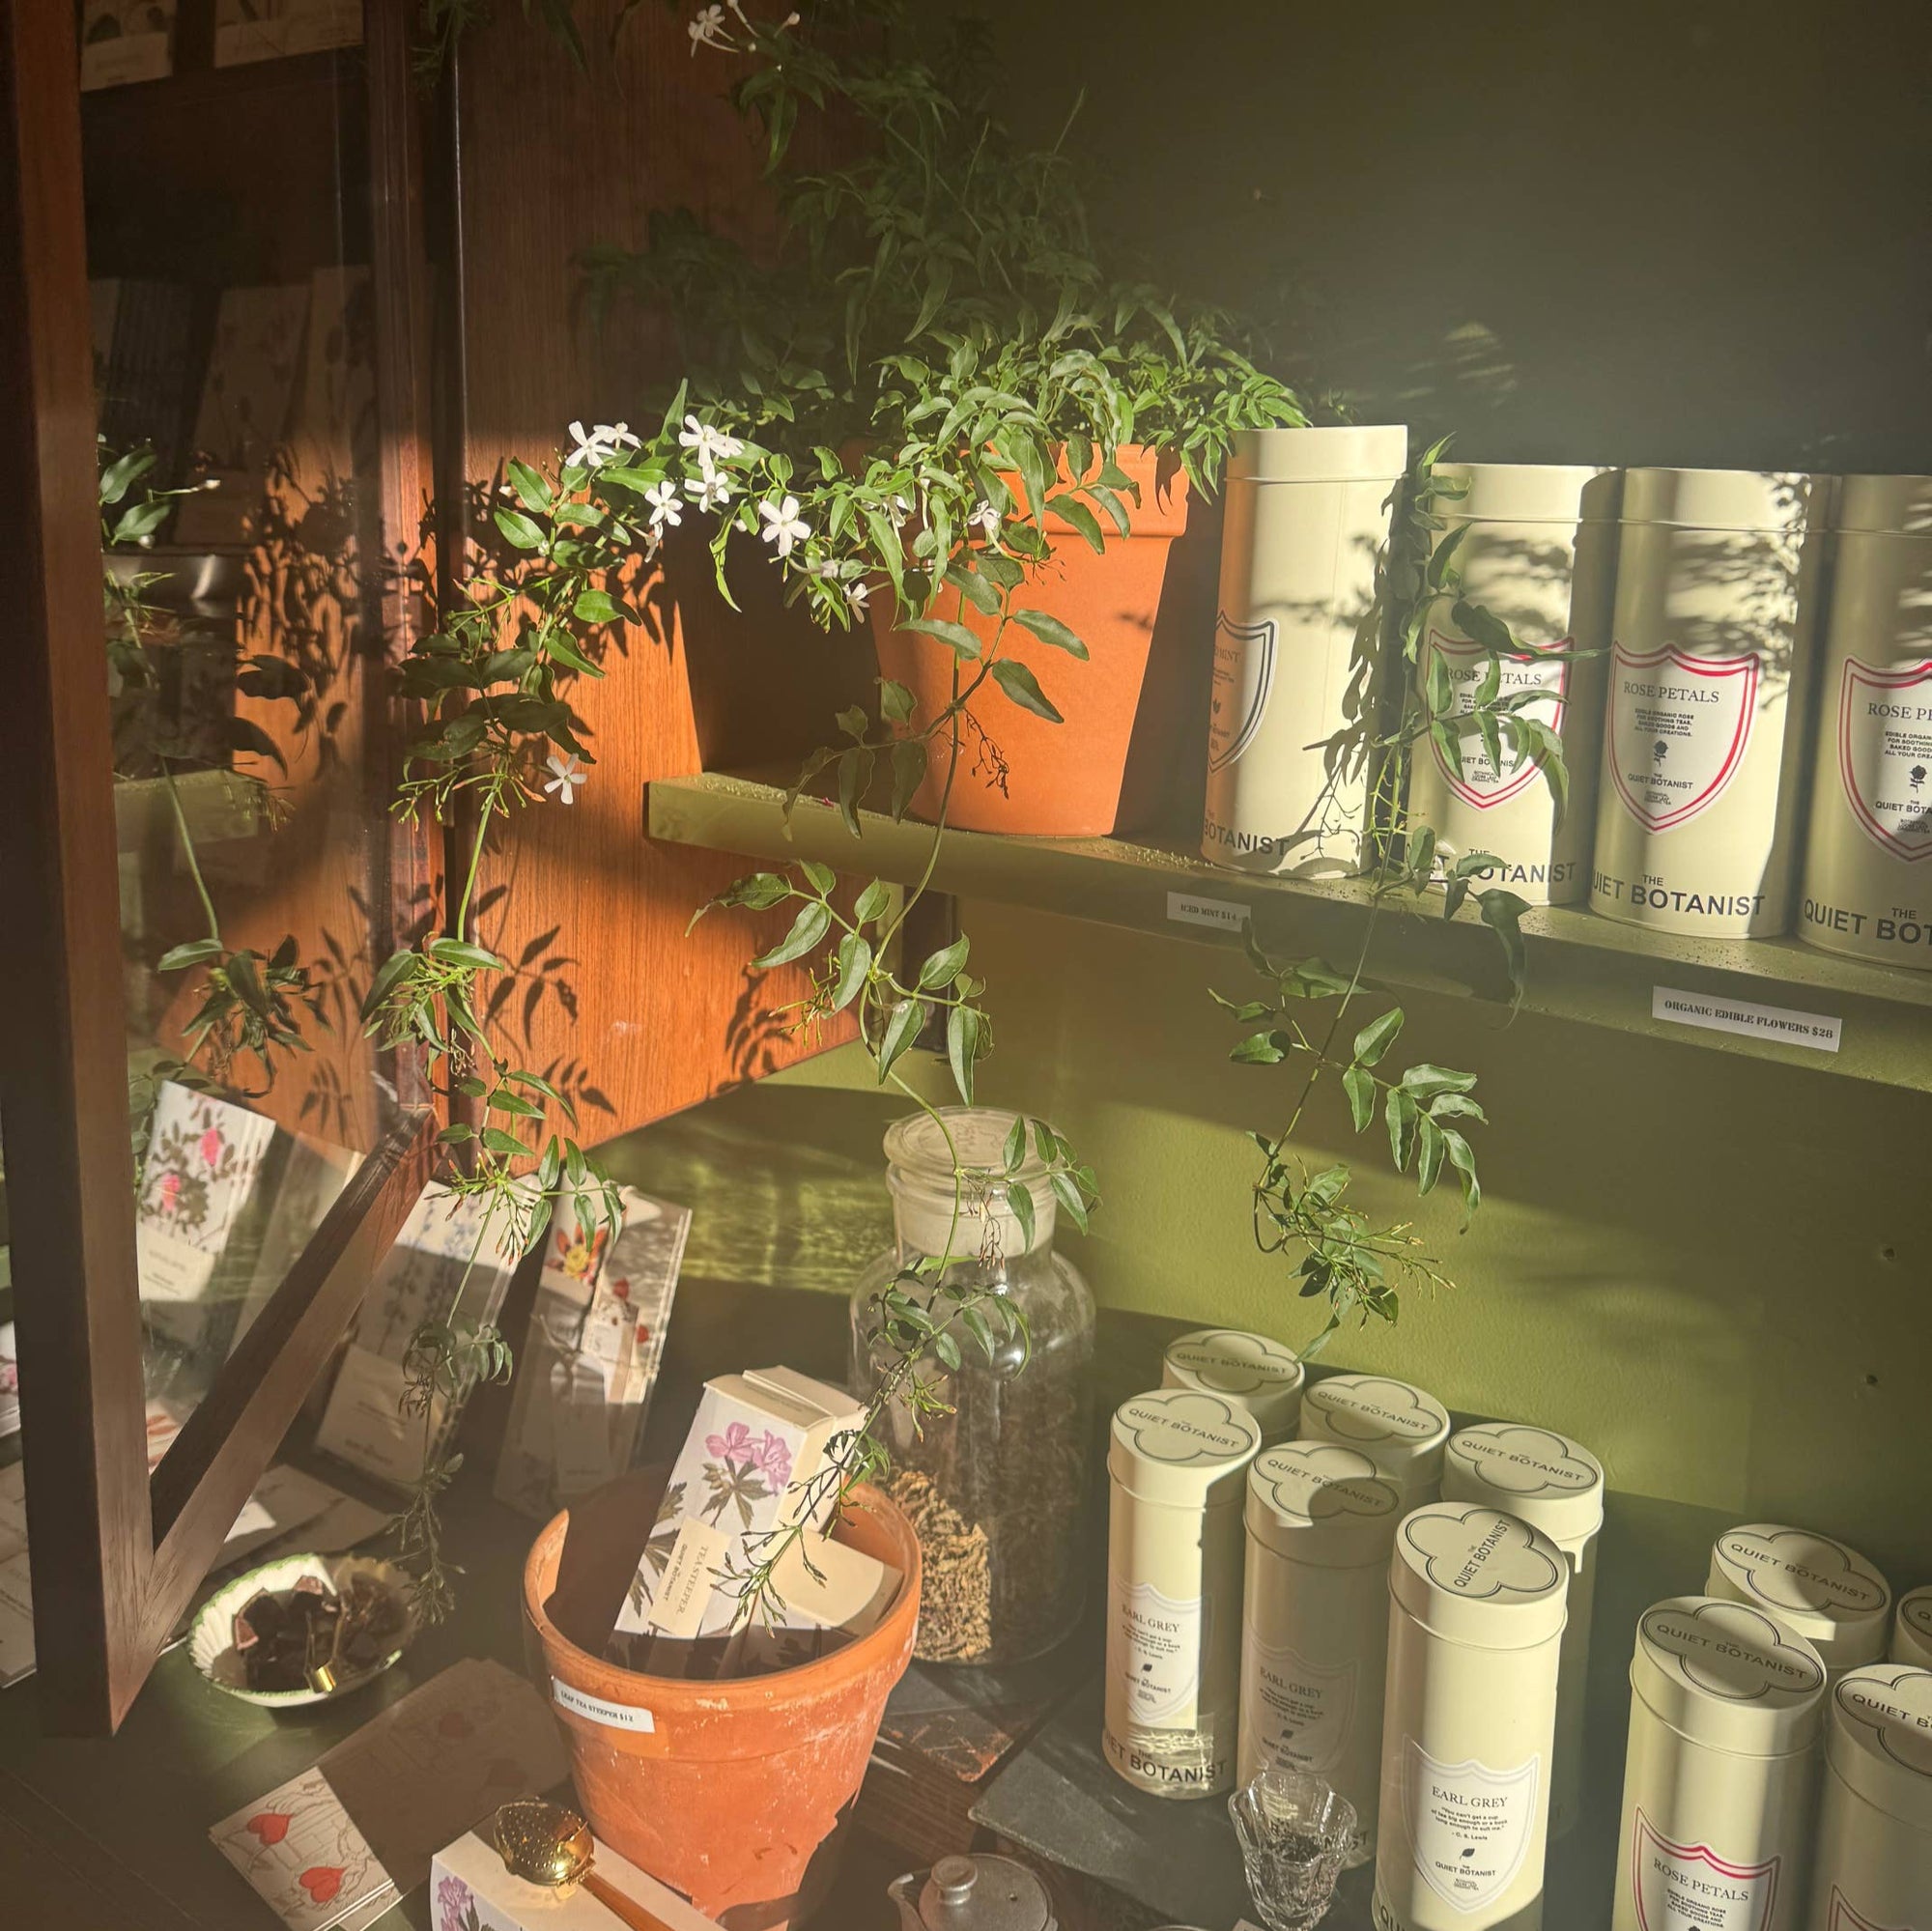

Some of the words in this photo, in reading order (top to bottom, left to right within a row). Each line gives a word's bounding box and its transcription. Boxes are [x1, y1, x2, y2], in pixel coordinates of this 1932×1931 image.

[1623, 681, 1655, 696] ROSE
[1659, 687, 1719, 703] PETALS
[1868, 702, 1912, 719] ROSE
[1628, 773, 1649, 783] QUIET
[1651, 778, 1693, 789] BOTANIST
[1875, 801, 1904, 811] QUIET
[1642, 874, 1663, 886] THE
[1180, 903, 1199, 914] ICED
[1201, 908, 1219, 919] MINT
[1631, 885, 1766, 916] BOTANIST
[1891, 907, 1917, 920] THE
[1804, 898, 1867, 935] QUIET
[1664, 999, 1712, 1017] ORGANIC
[1715, 1008, 1754, 1024] EDIBLE
[1756, 1017, 1809, 1035] FLOWERS
[1811, 1026, 1833, 1039] $28
[1177, 1352, 1215, 1364] QUIET
[1220, 1358, 1286, 1374] BOTANIST
[1318, 1391, 1357, 1407] QUIET
[1360, 1405, 1430, 1430] BOTANIST
[1128, 1407, 1169, 1425] QUIET
[1170, 1422, 1239, 1447] BOTANIST
[1462, 1439, 1506, 1457] QUIET
[1509, 1455, 1584, 1481] BOTANIST
[1267, 1459, 1310, 1478] QUIET
[1311, 1476, 1384, 1507] BOTANIST
[1454, 1559, 1481, 1588] QUIET
[1473, 1519, 1511, 1562] BOTANIST
[1731, 1544, 1781, 1566] QUIET
[1784, 1564, 1870, 1601] BOTANIST
[1122, 1604, 1146, 1625] EARL
[1148, 1618, 1179, 1633] GREY
[1657, 1624, 1711, 1647] QUIET
[1716, 1643, 1808, 1679] BOTANIST
[1260, 1665, 1287, 1690] EARL
[1289, 1683, 1322, 1698] GREY
[560, 1690, 574, 1702] LEAF
[576, 1699, 587, 1709] TEA
[588, 1705, 618, 1719] STEEPER
[619, 1713, 634, 1722] $12
[1853, 1693, 1911, 1720] QUIET
[1130, 1754, 1227, 1782] BOTANIST
[1432, 1786, 1468, 1805] EARL
[1470, 1797, 1508, 1808] GREY
[1449, 1821, 1470, 1830] enough
[1435, 1860, 1458, 1873] QUIET
[1460, 1868, 1496, 1877] BOTANIST
[1654, 1858, 1689, 1887] ROSE
[1691, 1880, 1749, 1901] PETALS
